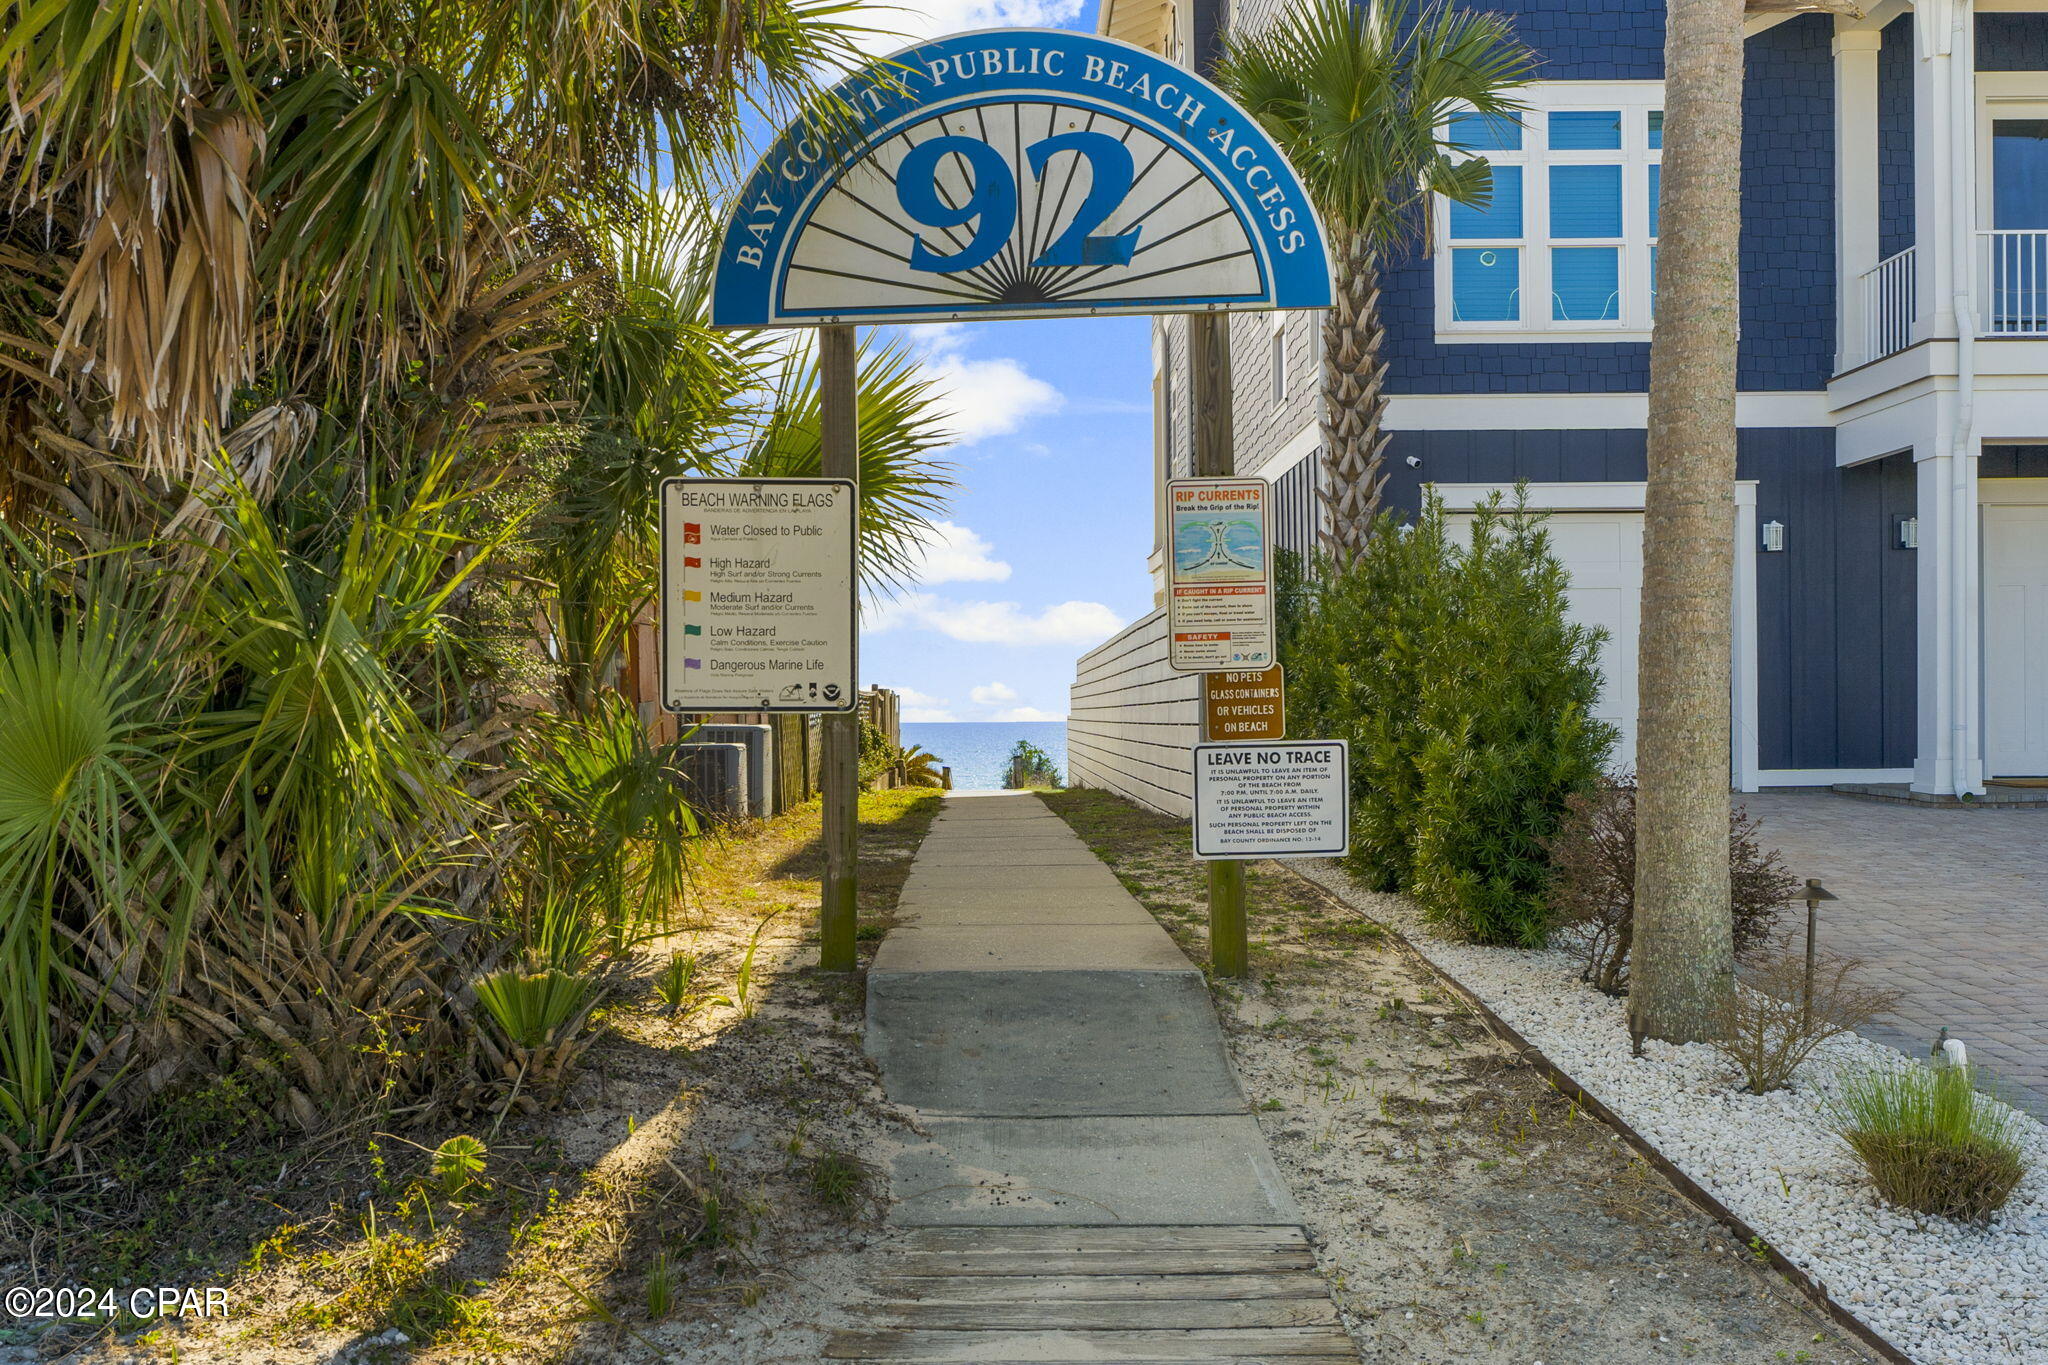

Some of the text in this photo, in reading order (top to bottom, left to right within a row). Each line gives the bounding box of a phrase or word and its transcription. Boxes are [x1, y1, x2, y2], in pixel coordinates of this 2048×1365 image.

[737, 188, 783, 270] BAY
[928, 48, 1064, 87] PUBLIC
[1082, 54, 1206, 128] BEACH
[1207, 128, 1306, 254] ACCESS
[896, 131, 1143, 273] 92
[682, 492, 725, 507] BEACH
[729, 493, 788, 507] WARNING
[1176, 490, 1260, 502] RIP CURRENTS
[710, 525, 823, 536] Water Closed to Public
[710, 558, 770, 571] High Hazard
[710, 592, 792, 602] Medium Hazard
[710, 626, 776, 636] Low Hazard
[710, 659, 824, 672] Dangerous Marine Life
[1226, 672, 1262, 683] NO PETS
[1211, 688, 1279, 700] GLASS CONTAINERS
[1217, 705, 1274, 716] OR VEHICLES
[1224, 722, 1268, 732] ON BEACH
[1208, 751, 1331, 766] LEAVE NO TRACE
